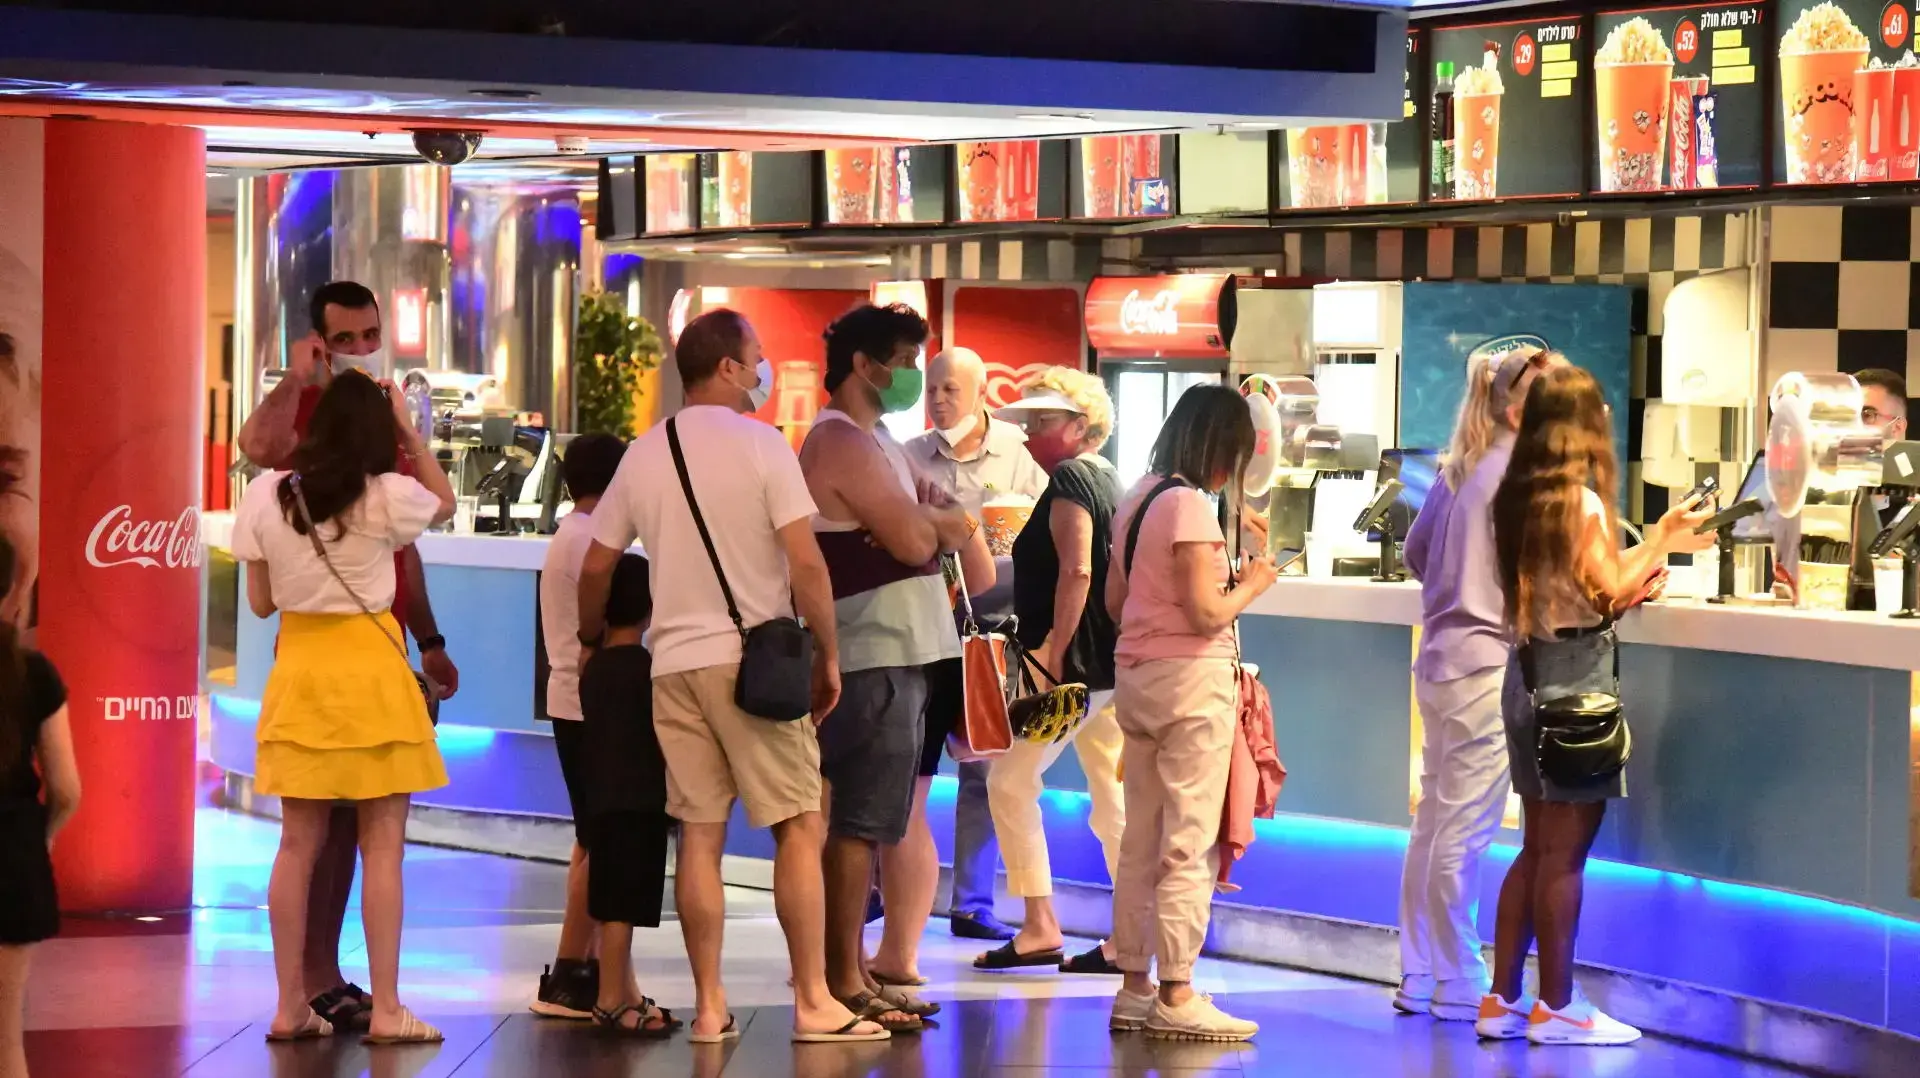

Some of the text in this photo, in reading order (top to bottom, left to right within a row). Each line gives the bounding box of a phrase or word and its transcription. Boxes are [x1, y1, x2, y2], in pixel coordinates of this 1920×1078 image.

[1700, 11, 1719, 31] חולק
[1721, 10, 1738, 27] שלא
[104, 696, 170, 720] החיים
